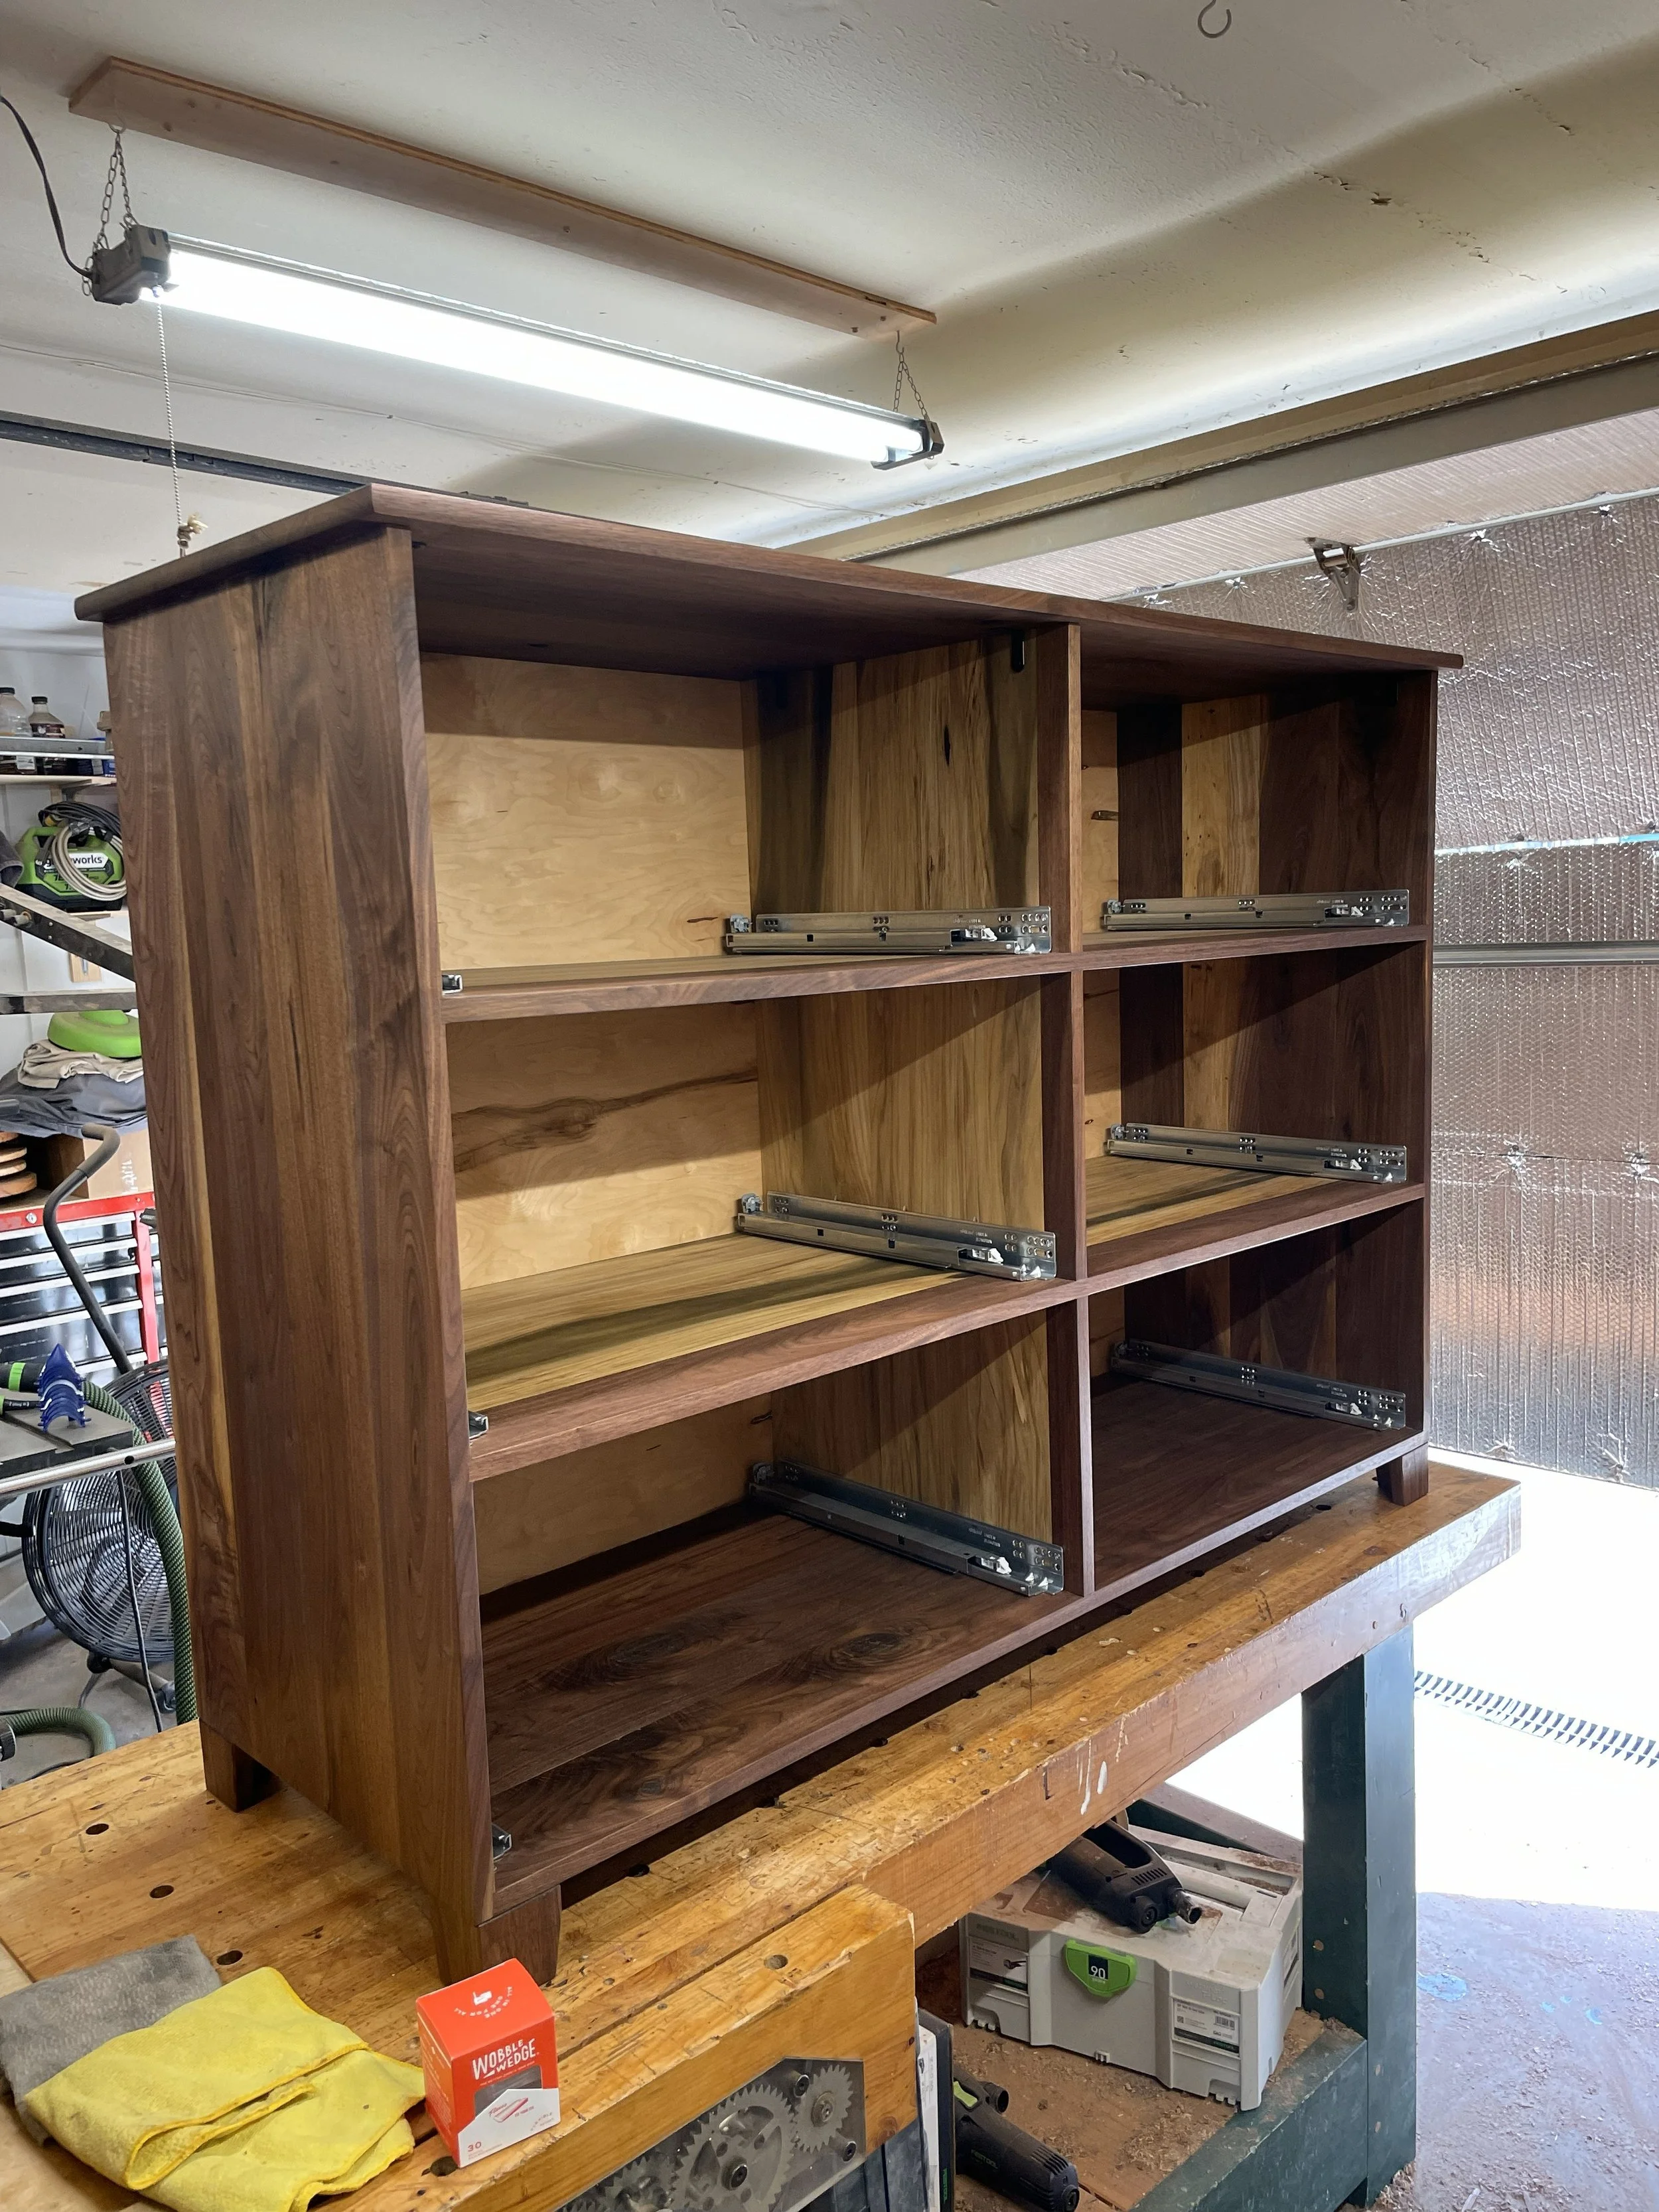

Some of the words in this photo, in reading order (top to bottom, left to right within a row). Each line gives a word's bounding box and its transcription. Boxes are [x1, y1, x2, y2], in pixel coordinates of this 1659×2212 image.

[1090, 1965, 1106, 1980] 90
[472, 2039, 524, 2081] WOBBLE
[496, 2037, 536, 2073] WEDGE
[467, 2141, 482, 2152] 30
